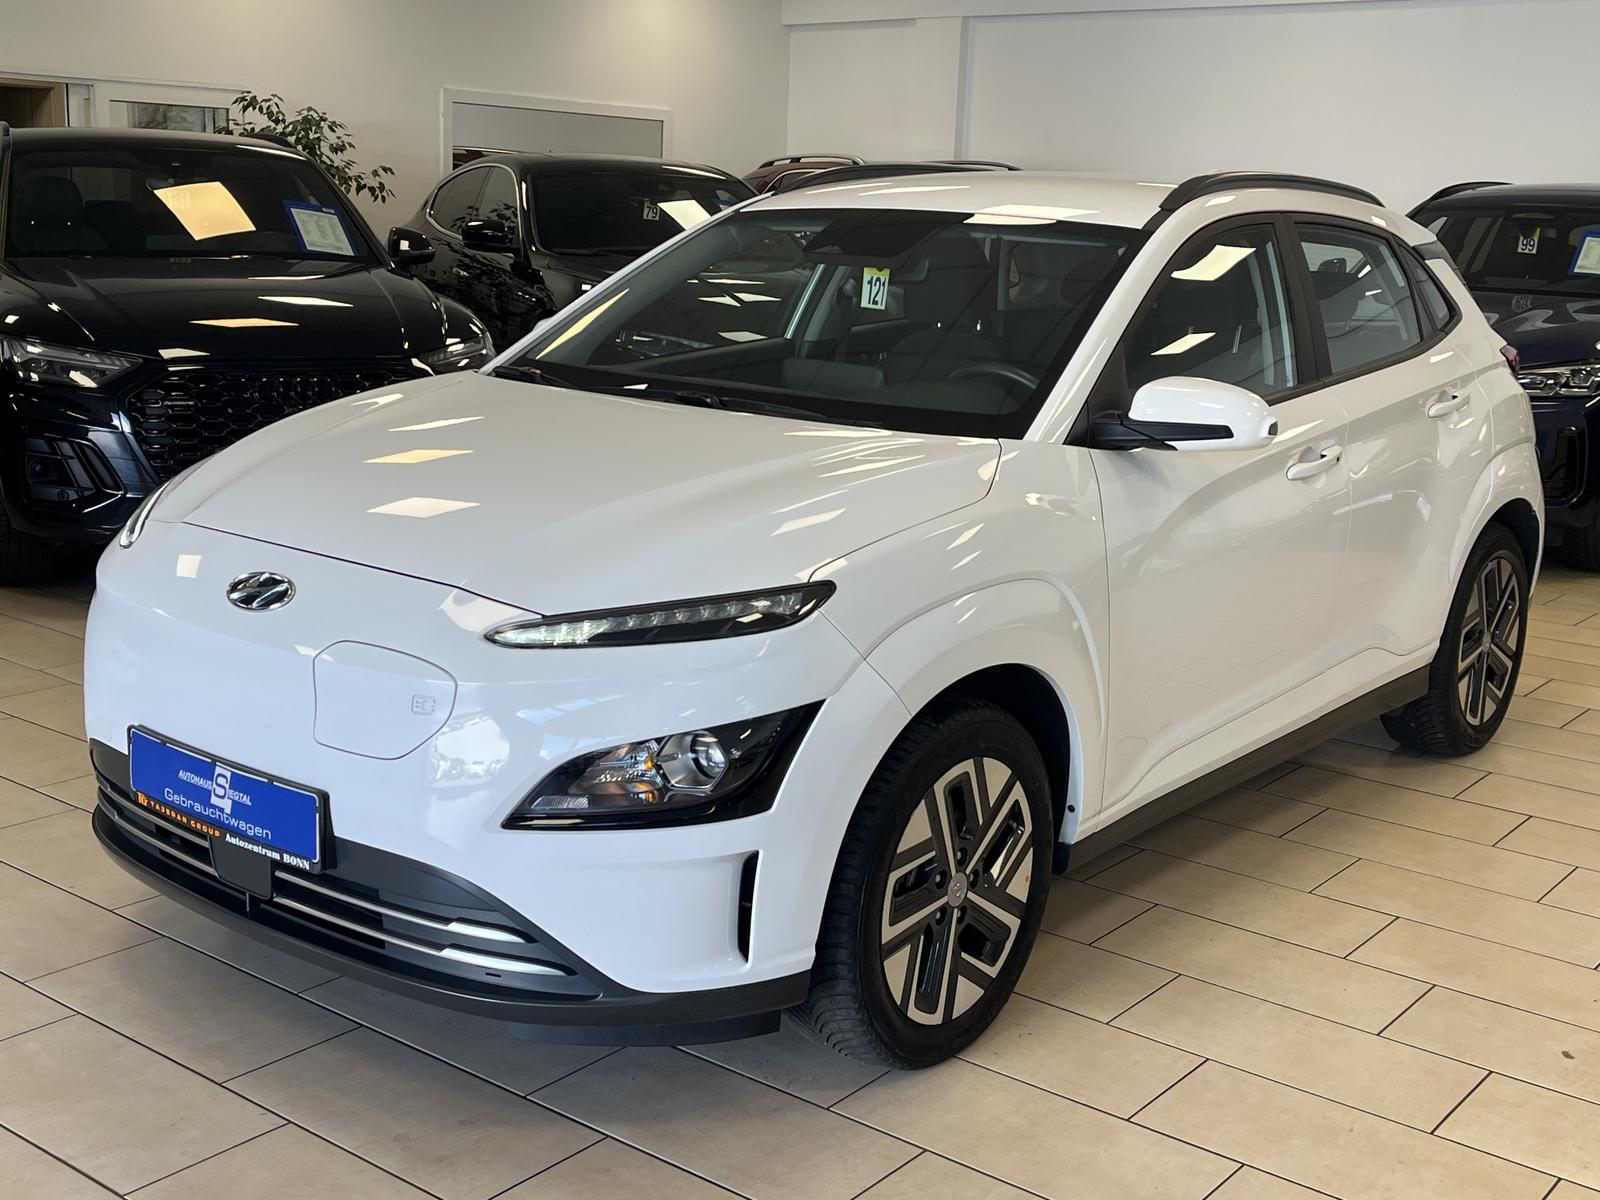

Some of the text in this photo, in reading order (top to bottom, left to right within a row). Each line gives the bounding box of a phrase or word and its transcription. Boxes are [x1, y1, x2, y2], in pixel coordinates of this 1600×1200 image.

[646, 206, 658, 219] 79
[1521, 238, 1535, 252] 99
[867, 275, 887, 306] 121
[178, 769, 213, 791] AUTOHAUS
[164, 787, 272, 840] Gebrauchtwagen
[190, 820, 221, 837] GROUP
[225, 833, 310, 870] Autozentrum BONN
